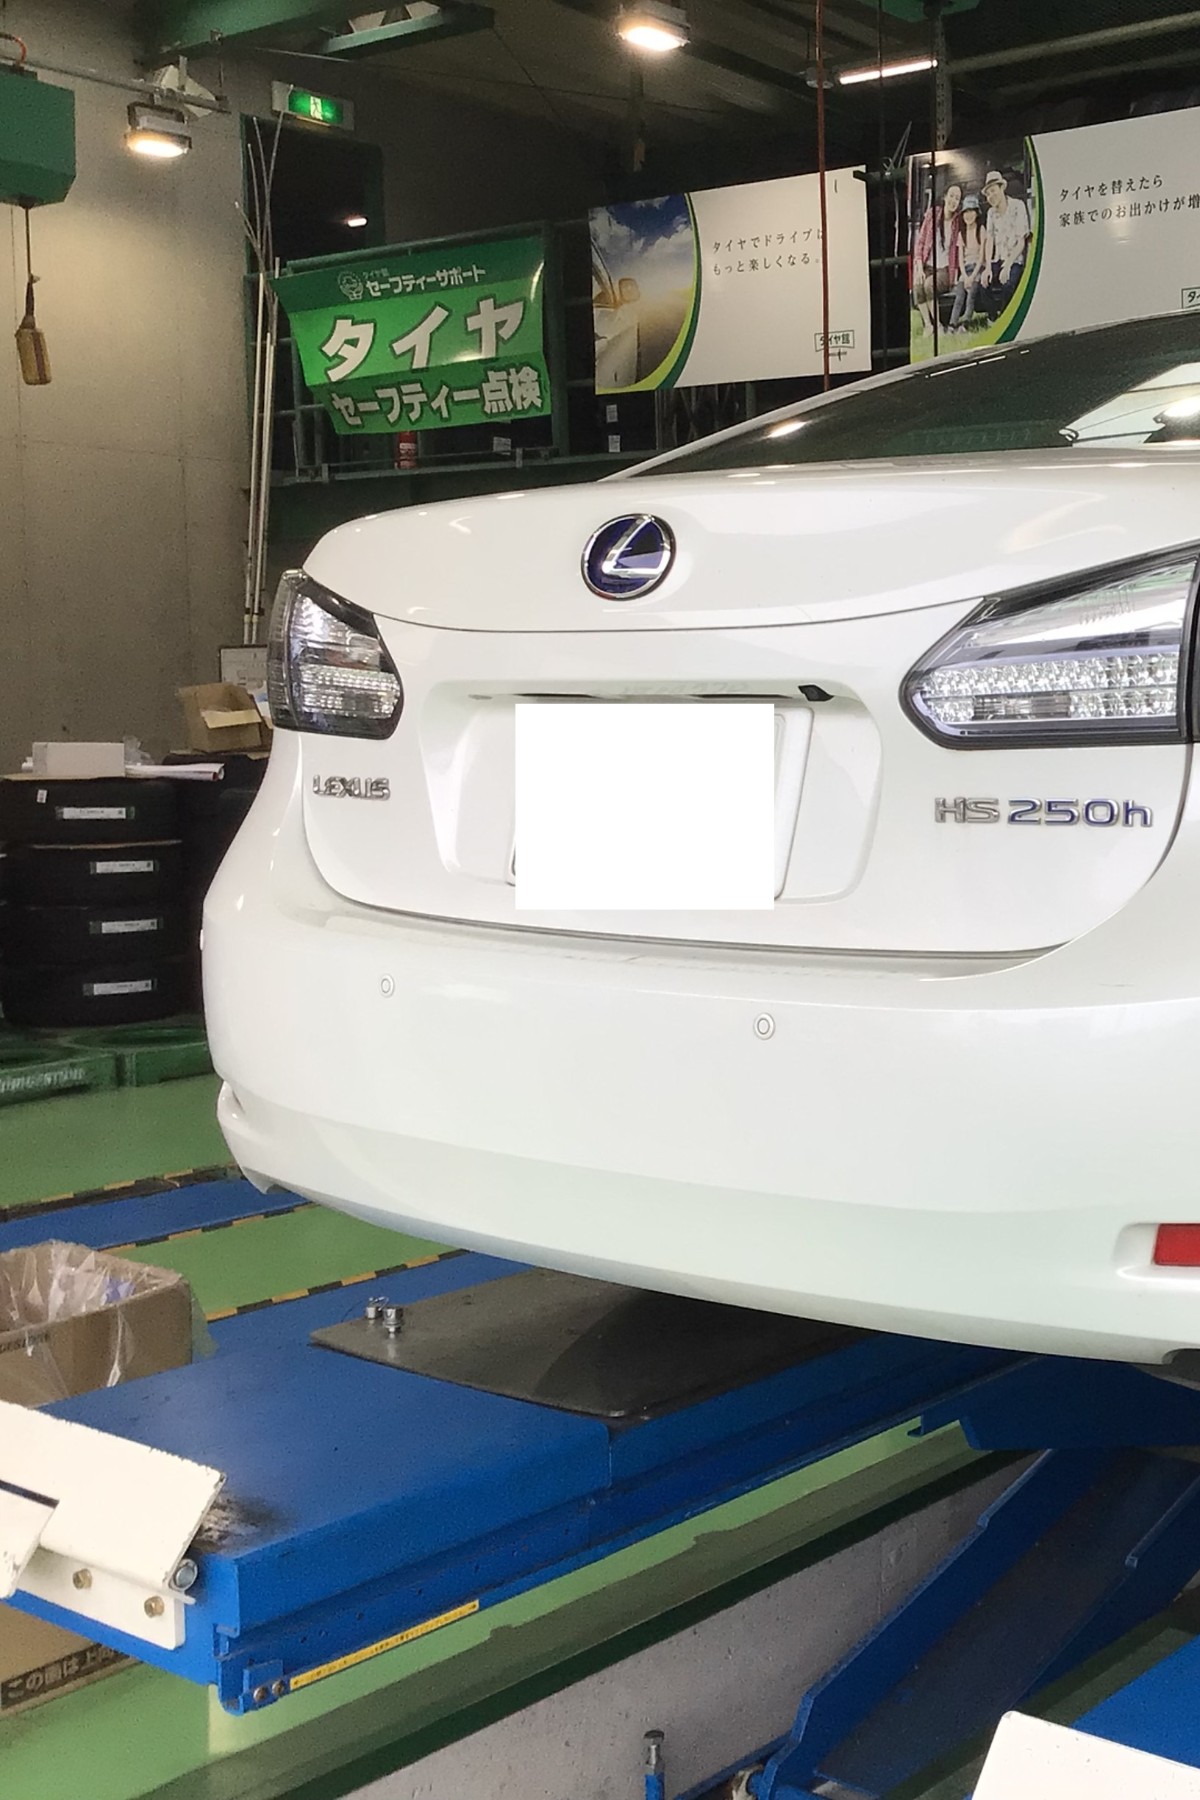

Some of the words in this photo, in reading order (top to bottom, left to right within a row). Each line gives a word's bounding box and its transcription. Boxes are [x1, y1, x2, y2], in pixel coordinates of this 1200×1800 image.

[1059, 174, 1164, 202] タイヤを替えたら
[712, 252, 819, 276] もっと楽しくなる。
[365, 264, 486, 297] セーフティーサポート
[320, 298, 525, 383] タイヤ
[331, 366, 543, 426] セーフティー点検
[312, 774, 391, 801] LEXUS
[934, 796, 1000, 824] HS
[1007, 797, 1154, 828] 250h
